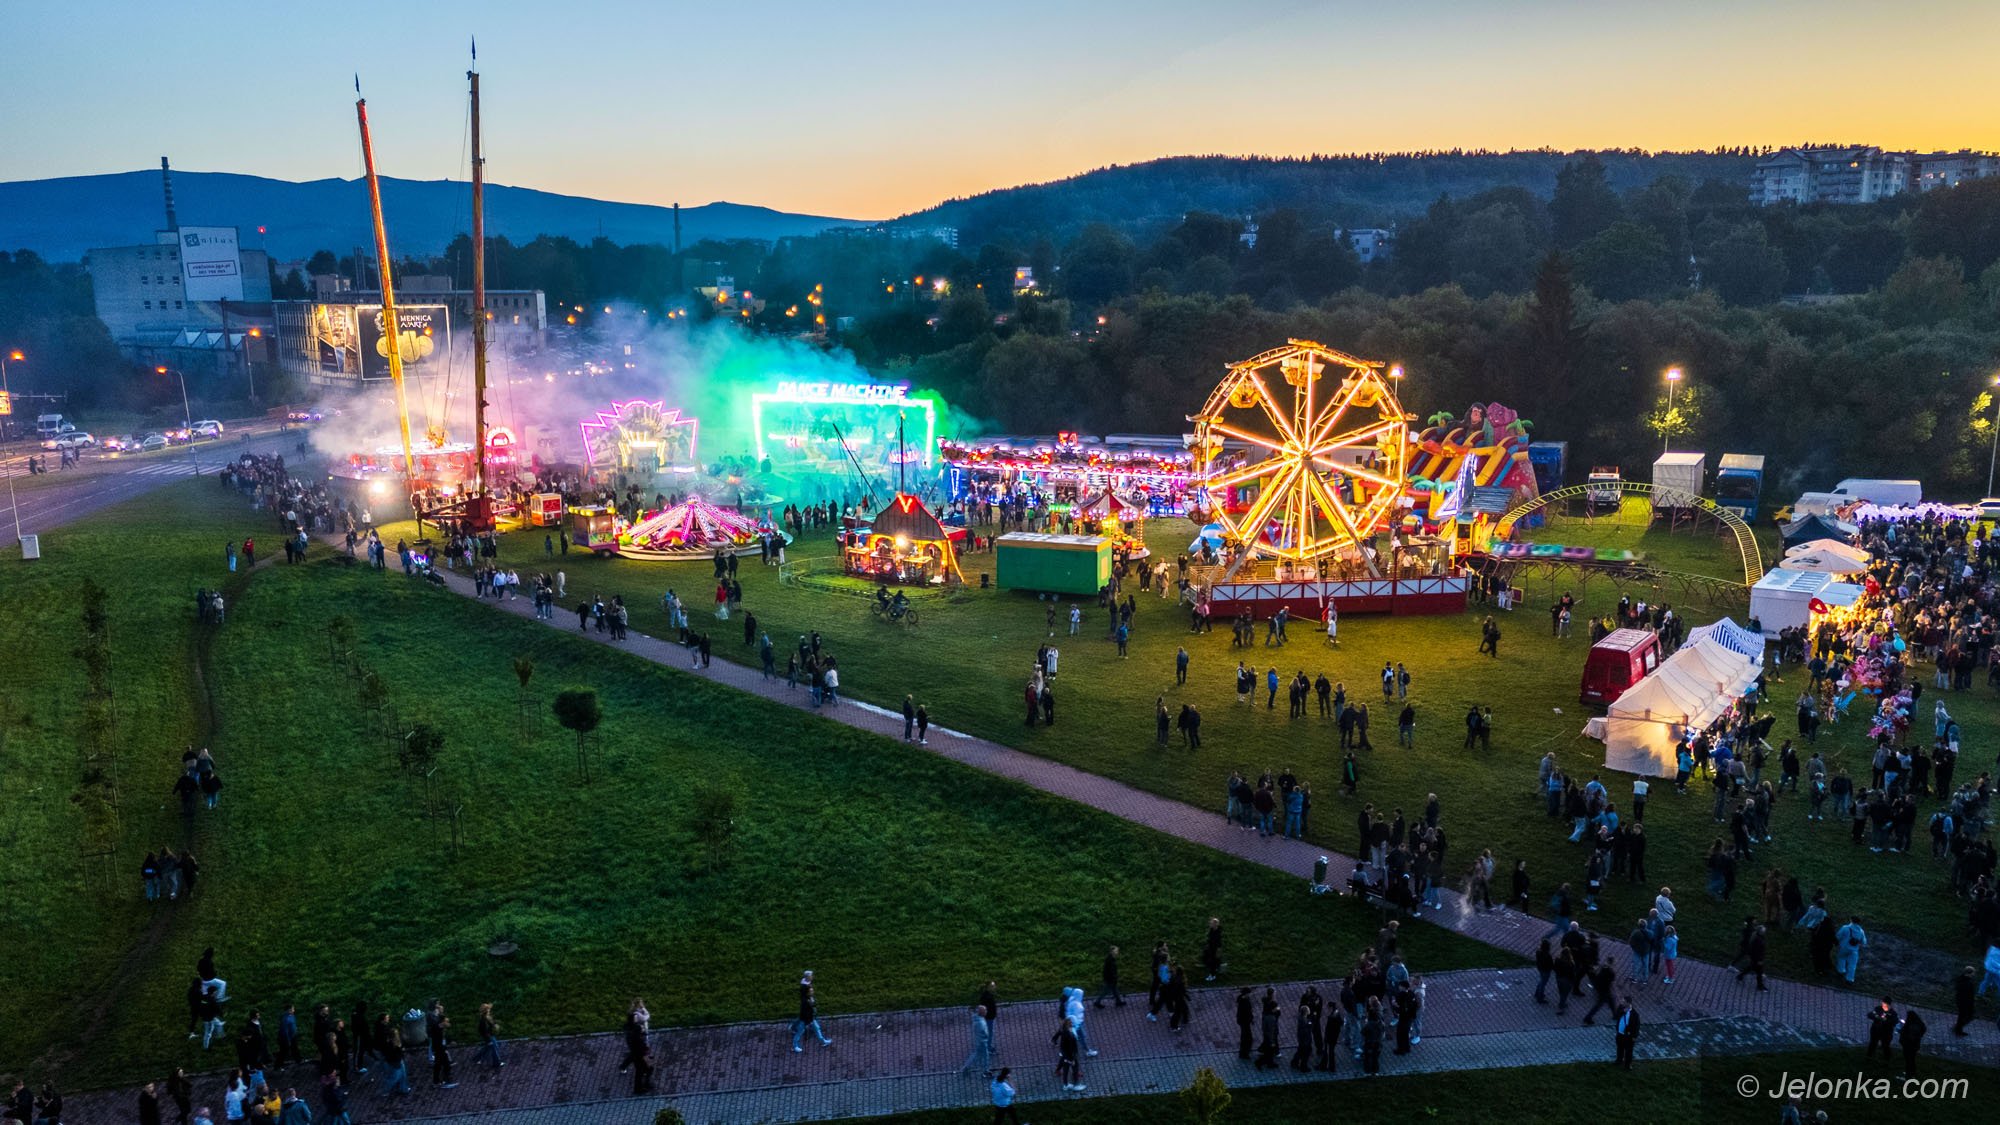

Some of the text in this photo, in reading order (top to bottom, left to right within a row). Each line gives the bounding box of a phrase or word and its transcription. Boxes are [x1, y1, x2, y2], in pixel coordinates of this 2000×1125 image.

[400, 314, 432, 322] MENNICA
[777, 382, 908, 401] DANCE MACHINE
